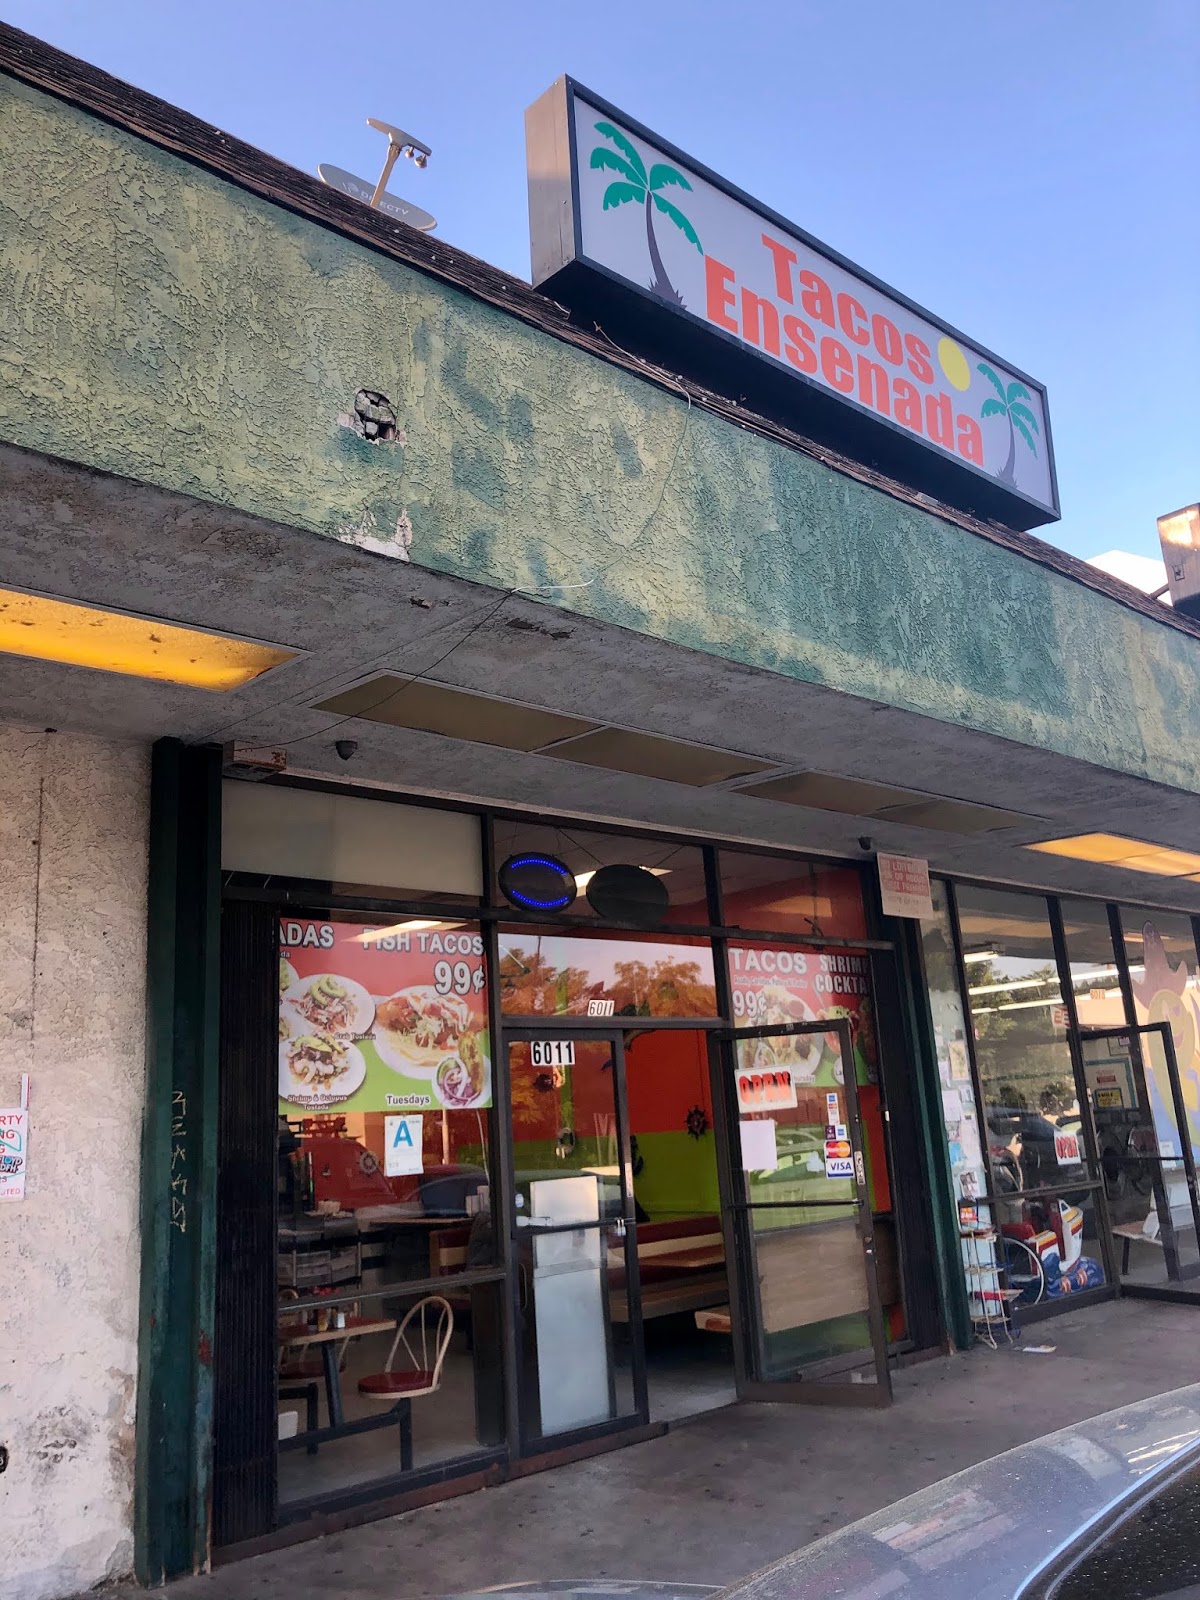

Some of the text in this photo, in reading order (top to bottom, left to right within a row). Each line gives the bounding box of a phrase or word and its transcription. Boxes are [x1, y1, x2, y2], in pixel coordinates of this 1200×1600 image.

[360, 190, 409, 216] DIECTV
[761, 234, 936, 386] Tacos
[704, 254, 984, 467] Ensenada
[416, 932, 485, 956] TACOS
[727, 947, 808, 975] TACOS
[434, 960, 486, 996] 99¢
[589, 1001, 613, 1016] 6011
[731, 989, 768, 1019] 99¢
[533, 1041, 573, 1065] 6011
[386, 1094, 431, 1106] Tuesdays
[738, 1070, 792, 1104] OPEN
[392, 1120, 414, 1149] A
[830, 1161, 852, 1171] VISA
